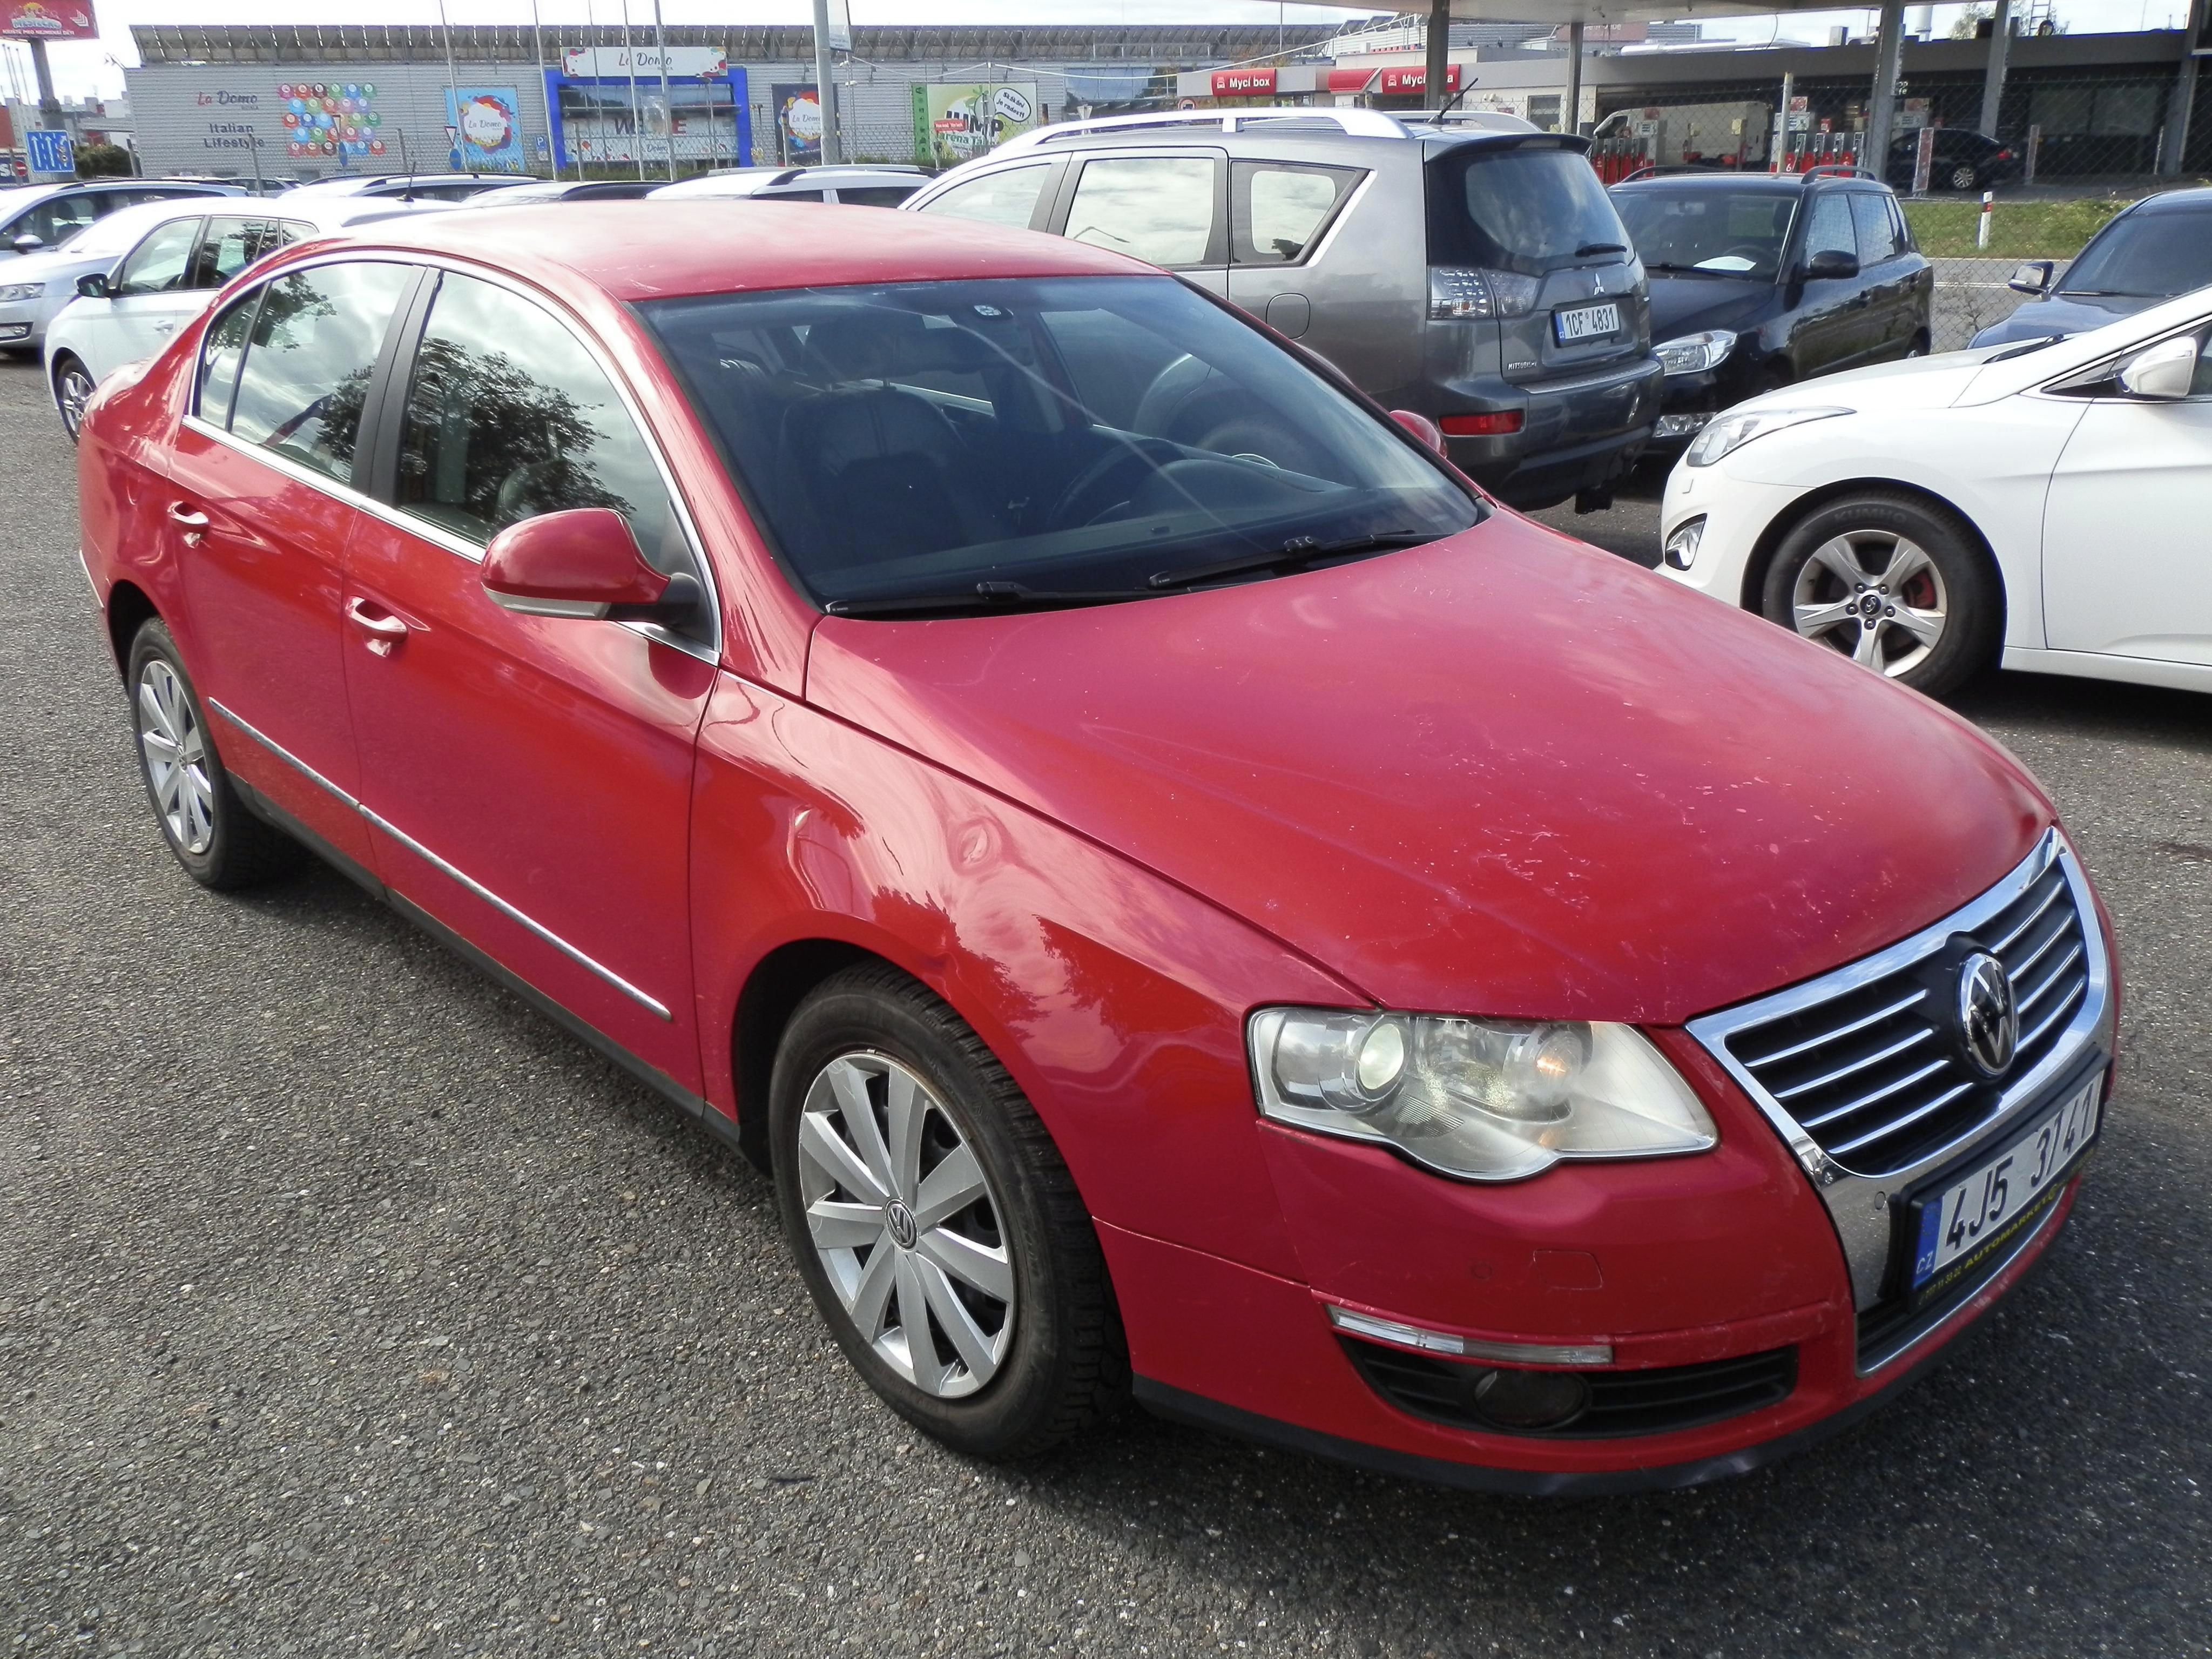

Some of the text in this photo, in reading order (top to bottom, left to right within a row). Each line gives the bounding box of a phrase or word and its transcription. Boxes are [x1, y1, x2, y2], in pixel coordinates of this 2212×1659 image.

[1229, 75, 1270, 90] Mycí box
[198, 91, 258, 105] La Domo
[208, 123, 254, 133] Italian
[469, 119, 502, 129] La Domo
[204, 138, 265, 150] Lifestye
[1786, 163, 1792, 172] 6
[1566, 307, 1615, 337] 1CF 4831
[1559, 331, 1565, 339] CZ
[1507, 360, 1537, 370] MITSUBISHI
[1834, 508, 1907, 524] KUMHO
[1946, 1082, 2094, 1251] 4J5 3141
[1916, 1250, 1933, 1275] CZ
